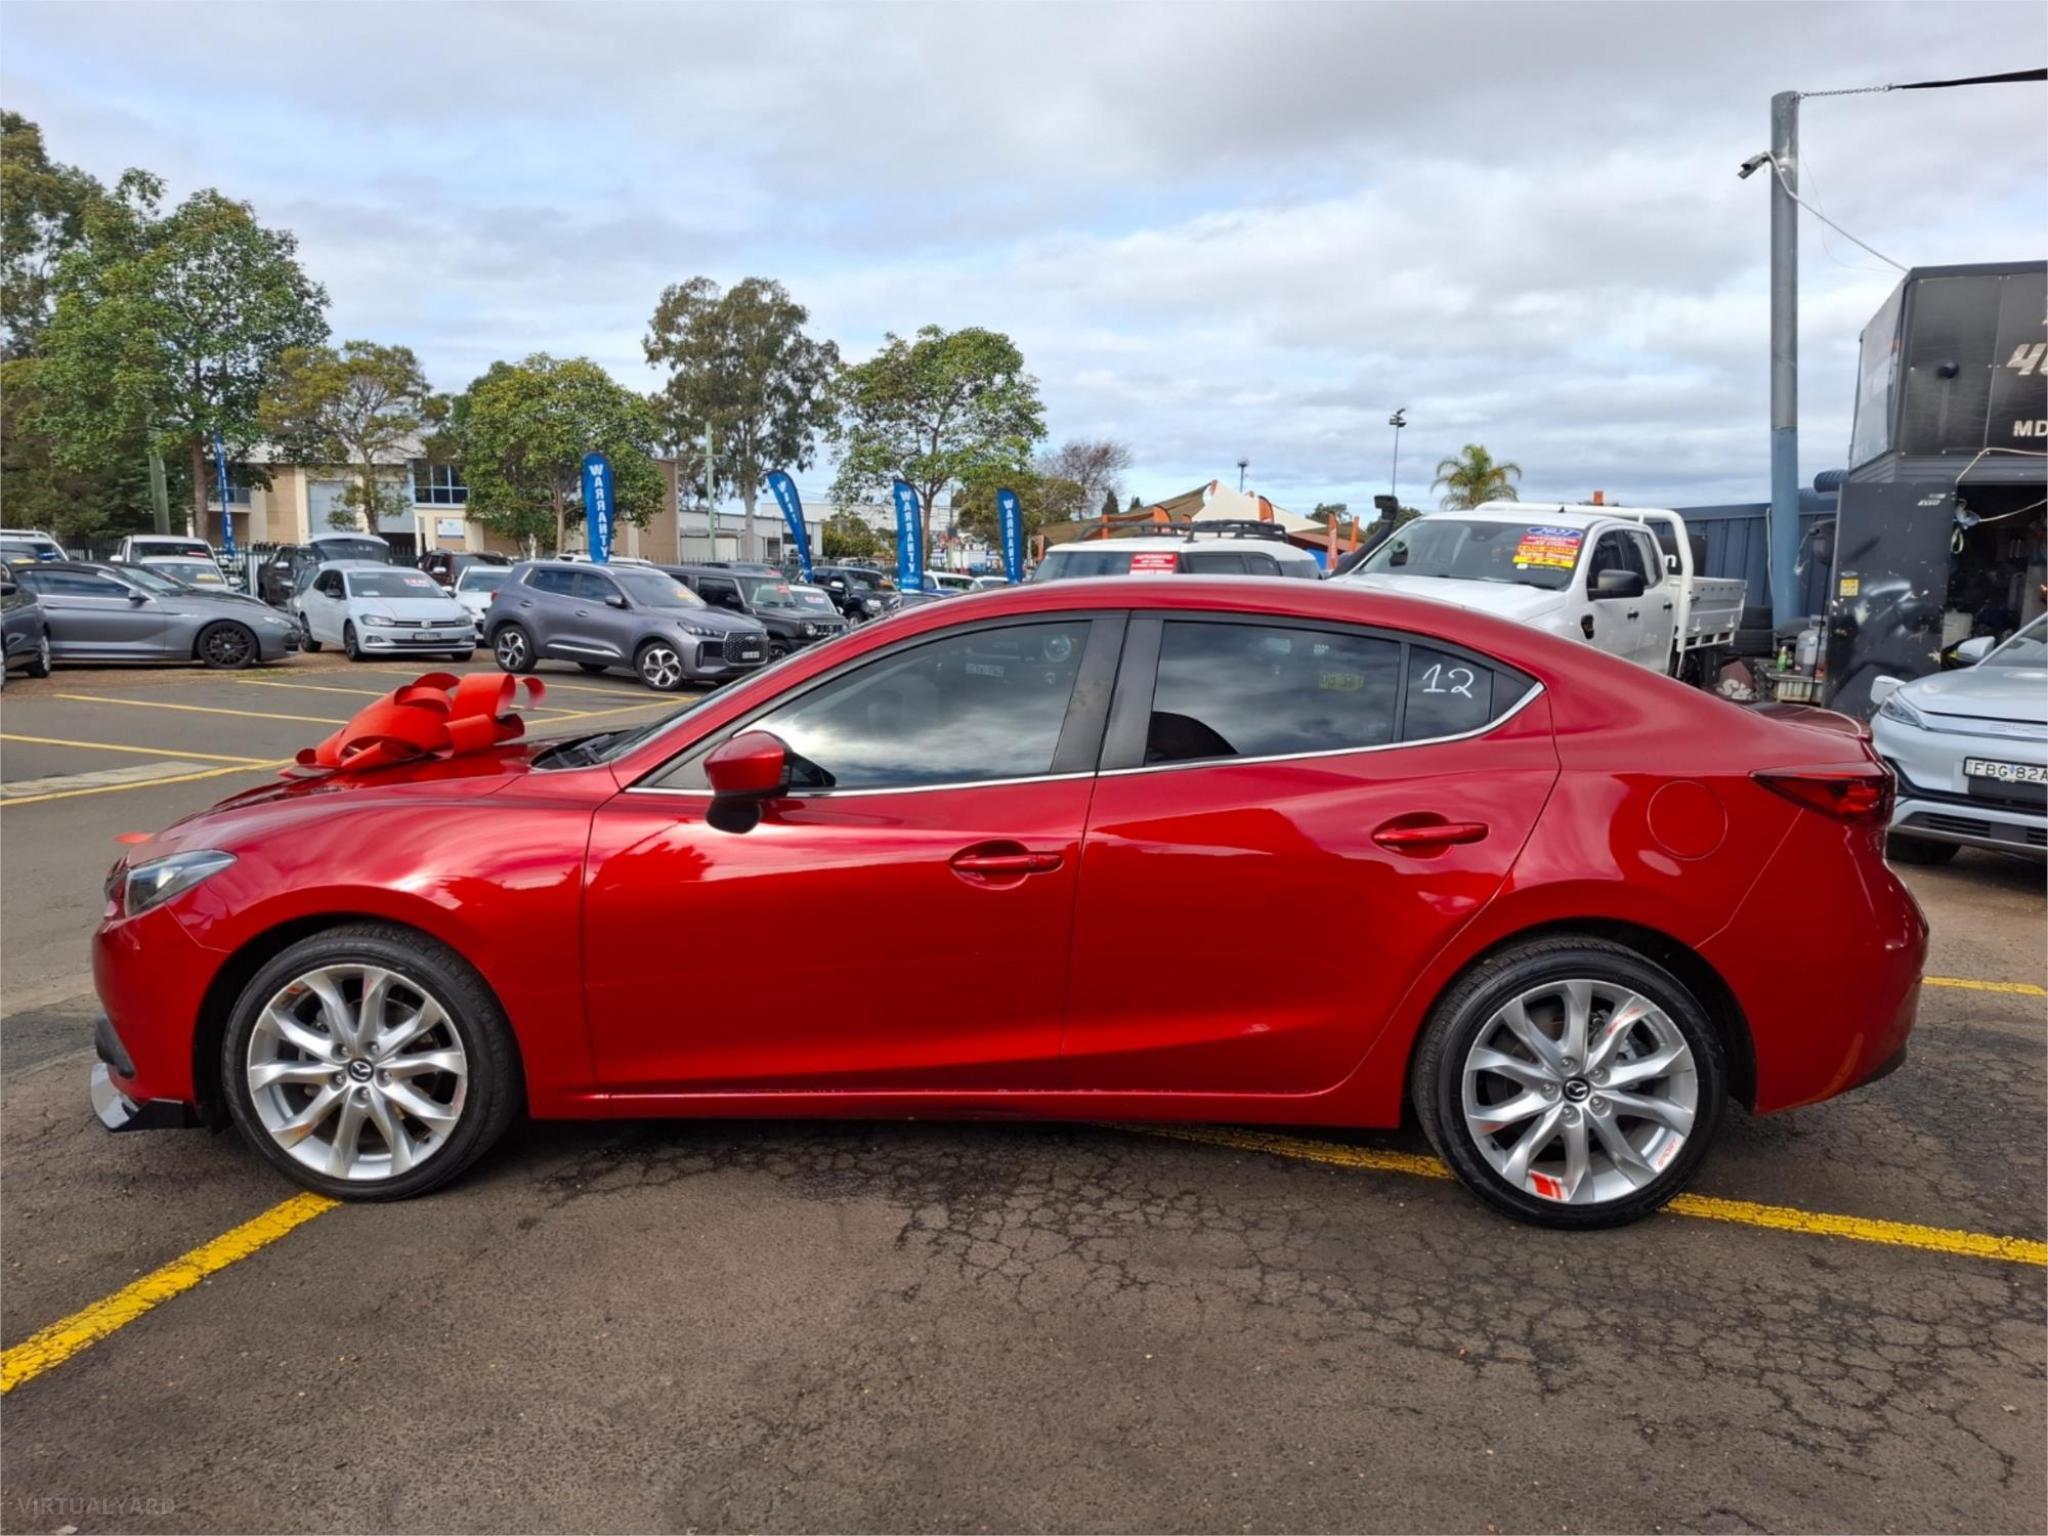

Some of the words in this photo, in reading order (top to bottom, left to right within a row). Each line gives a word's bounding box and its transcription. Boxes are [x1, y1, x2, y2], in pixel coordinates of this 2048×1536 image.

[588, 463, 609, 558] WARRANTY
[900, 490, 916, 573] WARRANTY
[1003, 498, 1015, 576] WARRANTY
[1422, 663, 1474, 698] 12
[1974, 762, 2008, 778] FBG
